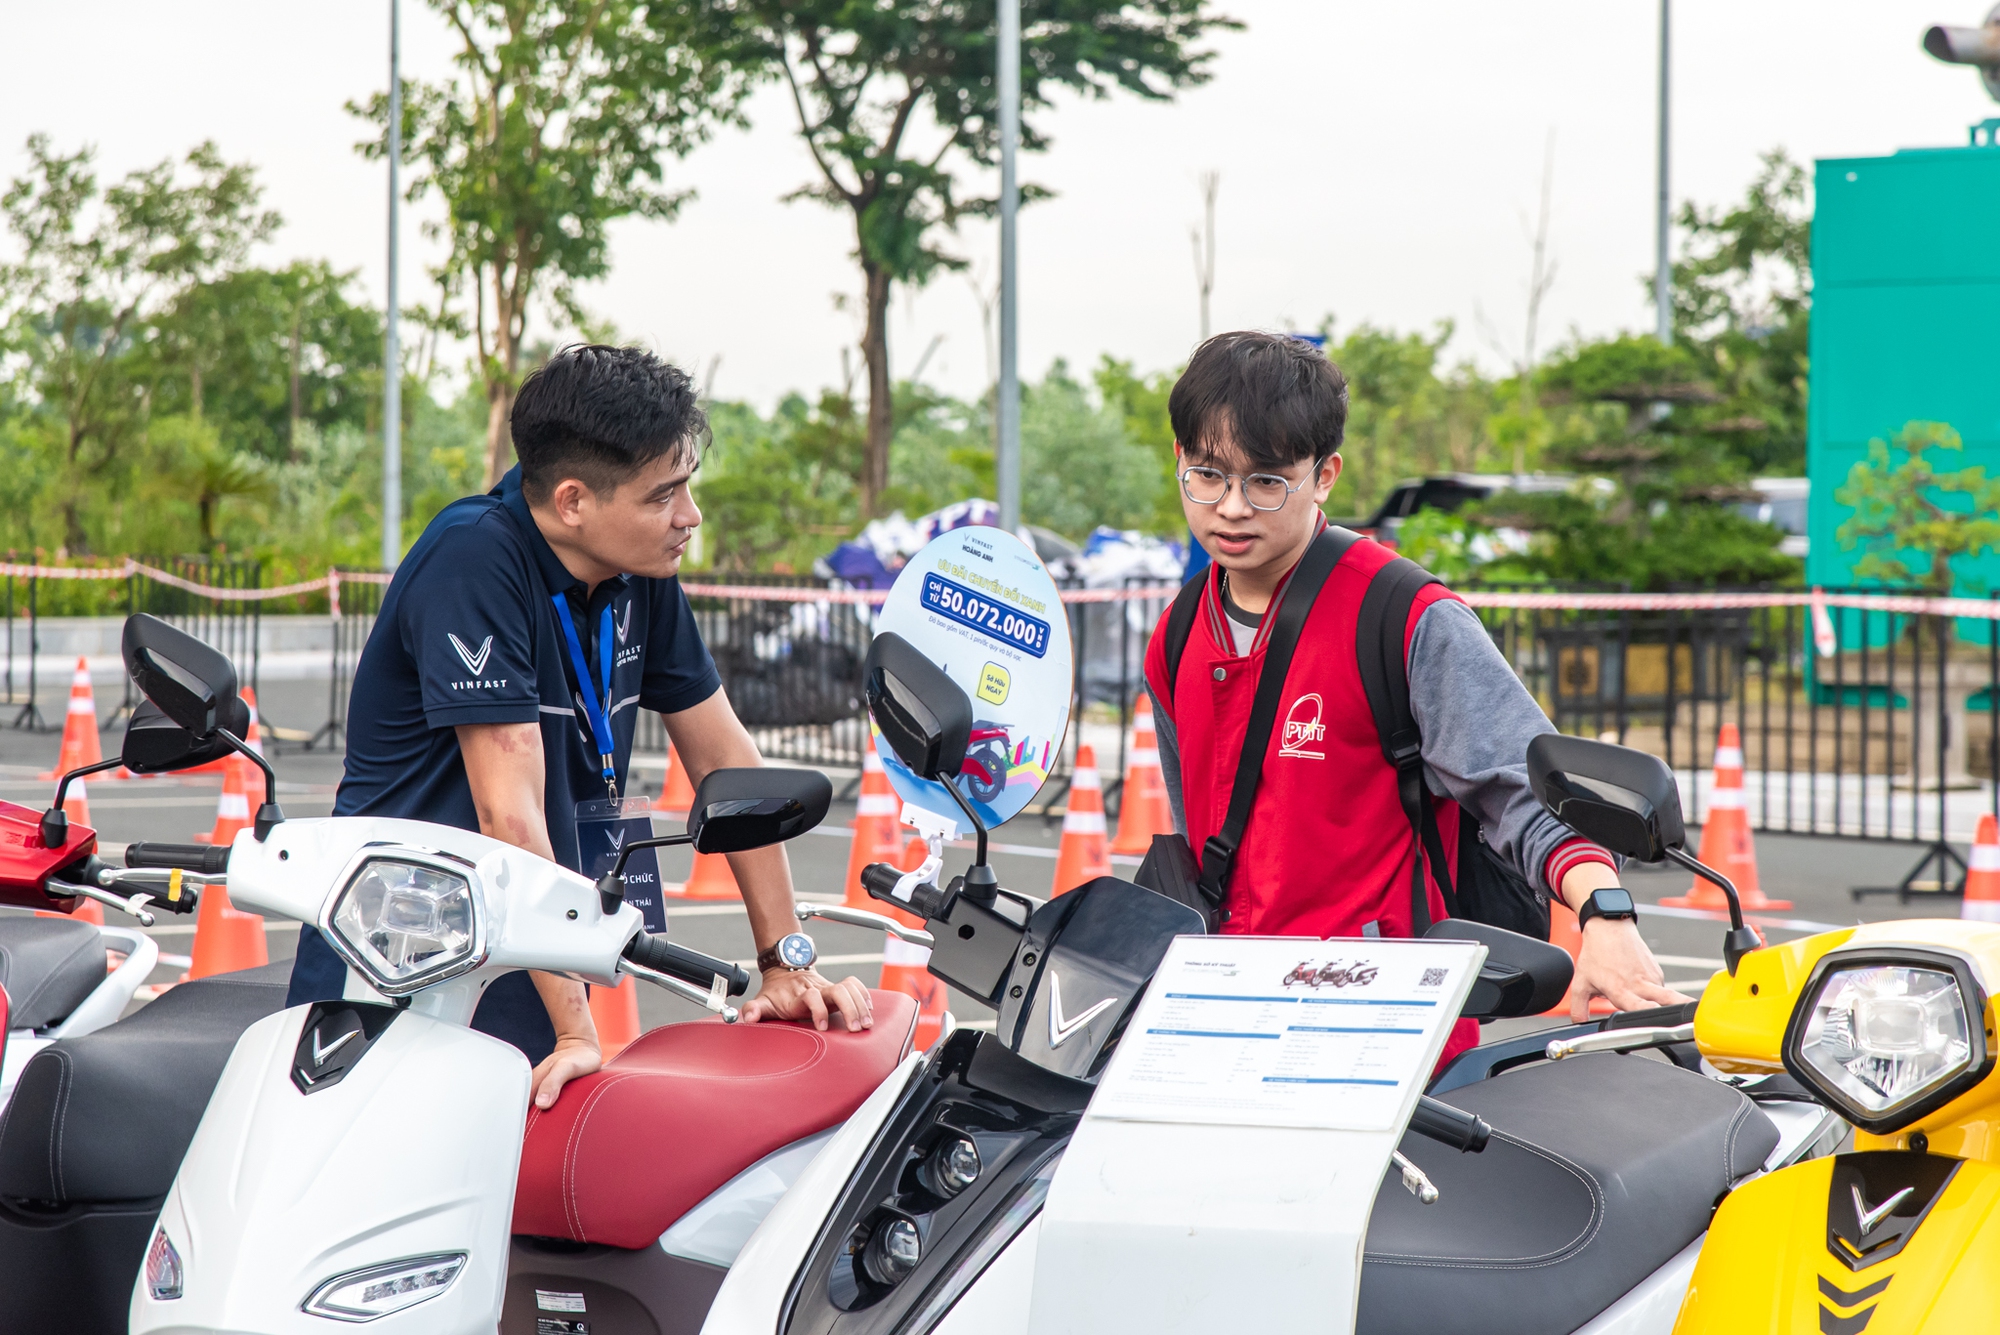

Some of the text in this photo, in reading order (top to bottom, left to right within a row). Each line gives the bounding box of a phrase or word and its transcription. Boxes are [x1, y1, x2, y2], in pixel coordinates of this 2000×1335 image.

[971, 537, 993, 550] VINFAST
[962, 544, 994, 563] HOÀNG ANH
[951, 564, 968, 581] ĐÃI
[1020, 594, 1047, 614] XANH
[940, 586, 1036, 645] 50.072.000
[936, 619, 947, 629] bao
[989, 643, 999, 653] quy
[451, 679, 507, 690] VINFAST
[985, 684, 1003, 696] NGAY
[629, 872, 655, 884] CHỨC
[635, 896, 652, 907] THÁI
